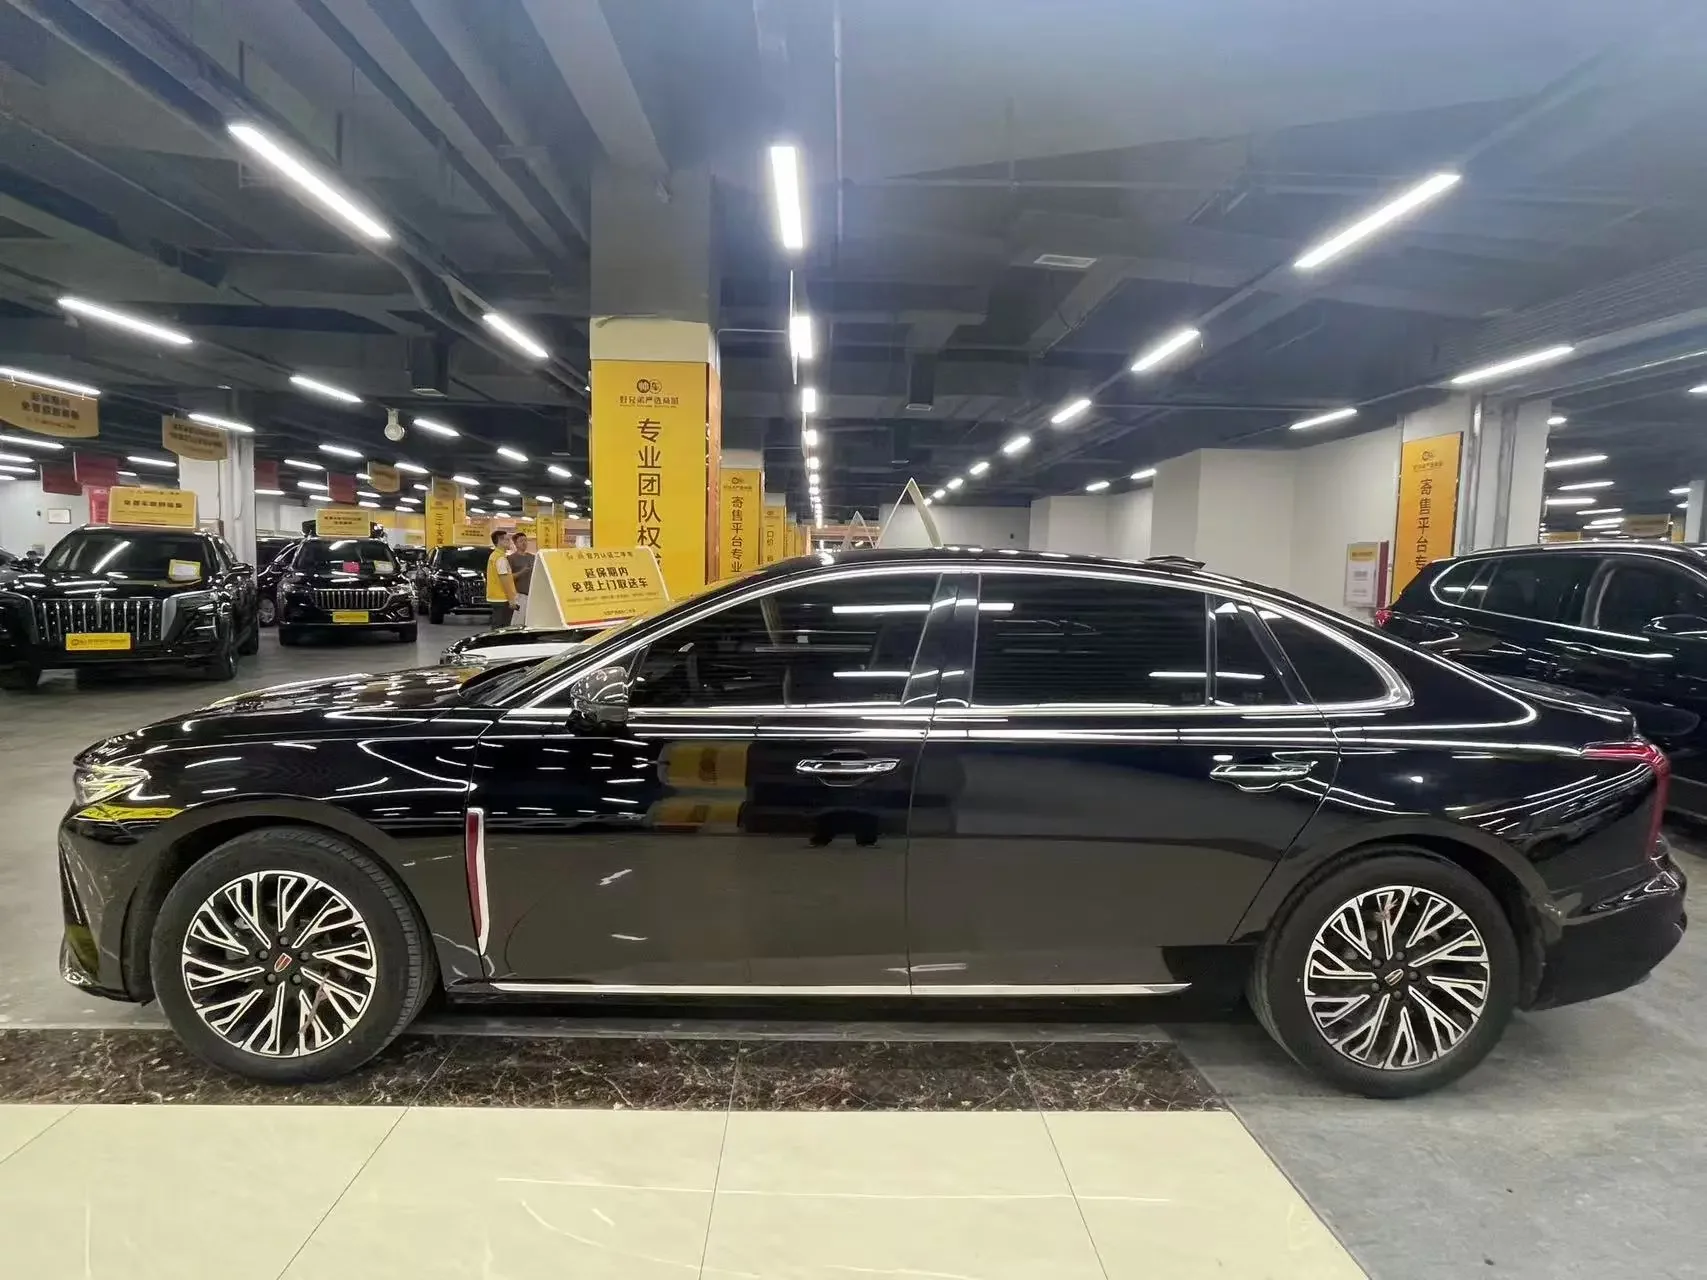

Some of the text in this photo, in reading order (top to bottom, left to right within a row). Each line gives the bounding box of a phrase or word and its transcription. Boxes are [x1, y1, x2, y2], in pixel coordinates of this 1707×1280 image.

[637, 418, 662, 572] 专业团队权
[731, 496, 744, 573] 寄售平台专业
[571, 577, 649, 593] 免费上门取送车
[584, 566, 629, 579] 延保期内
